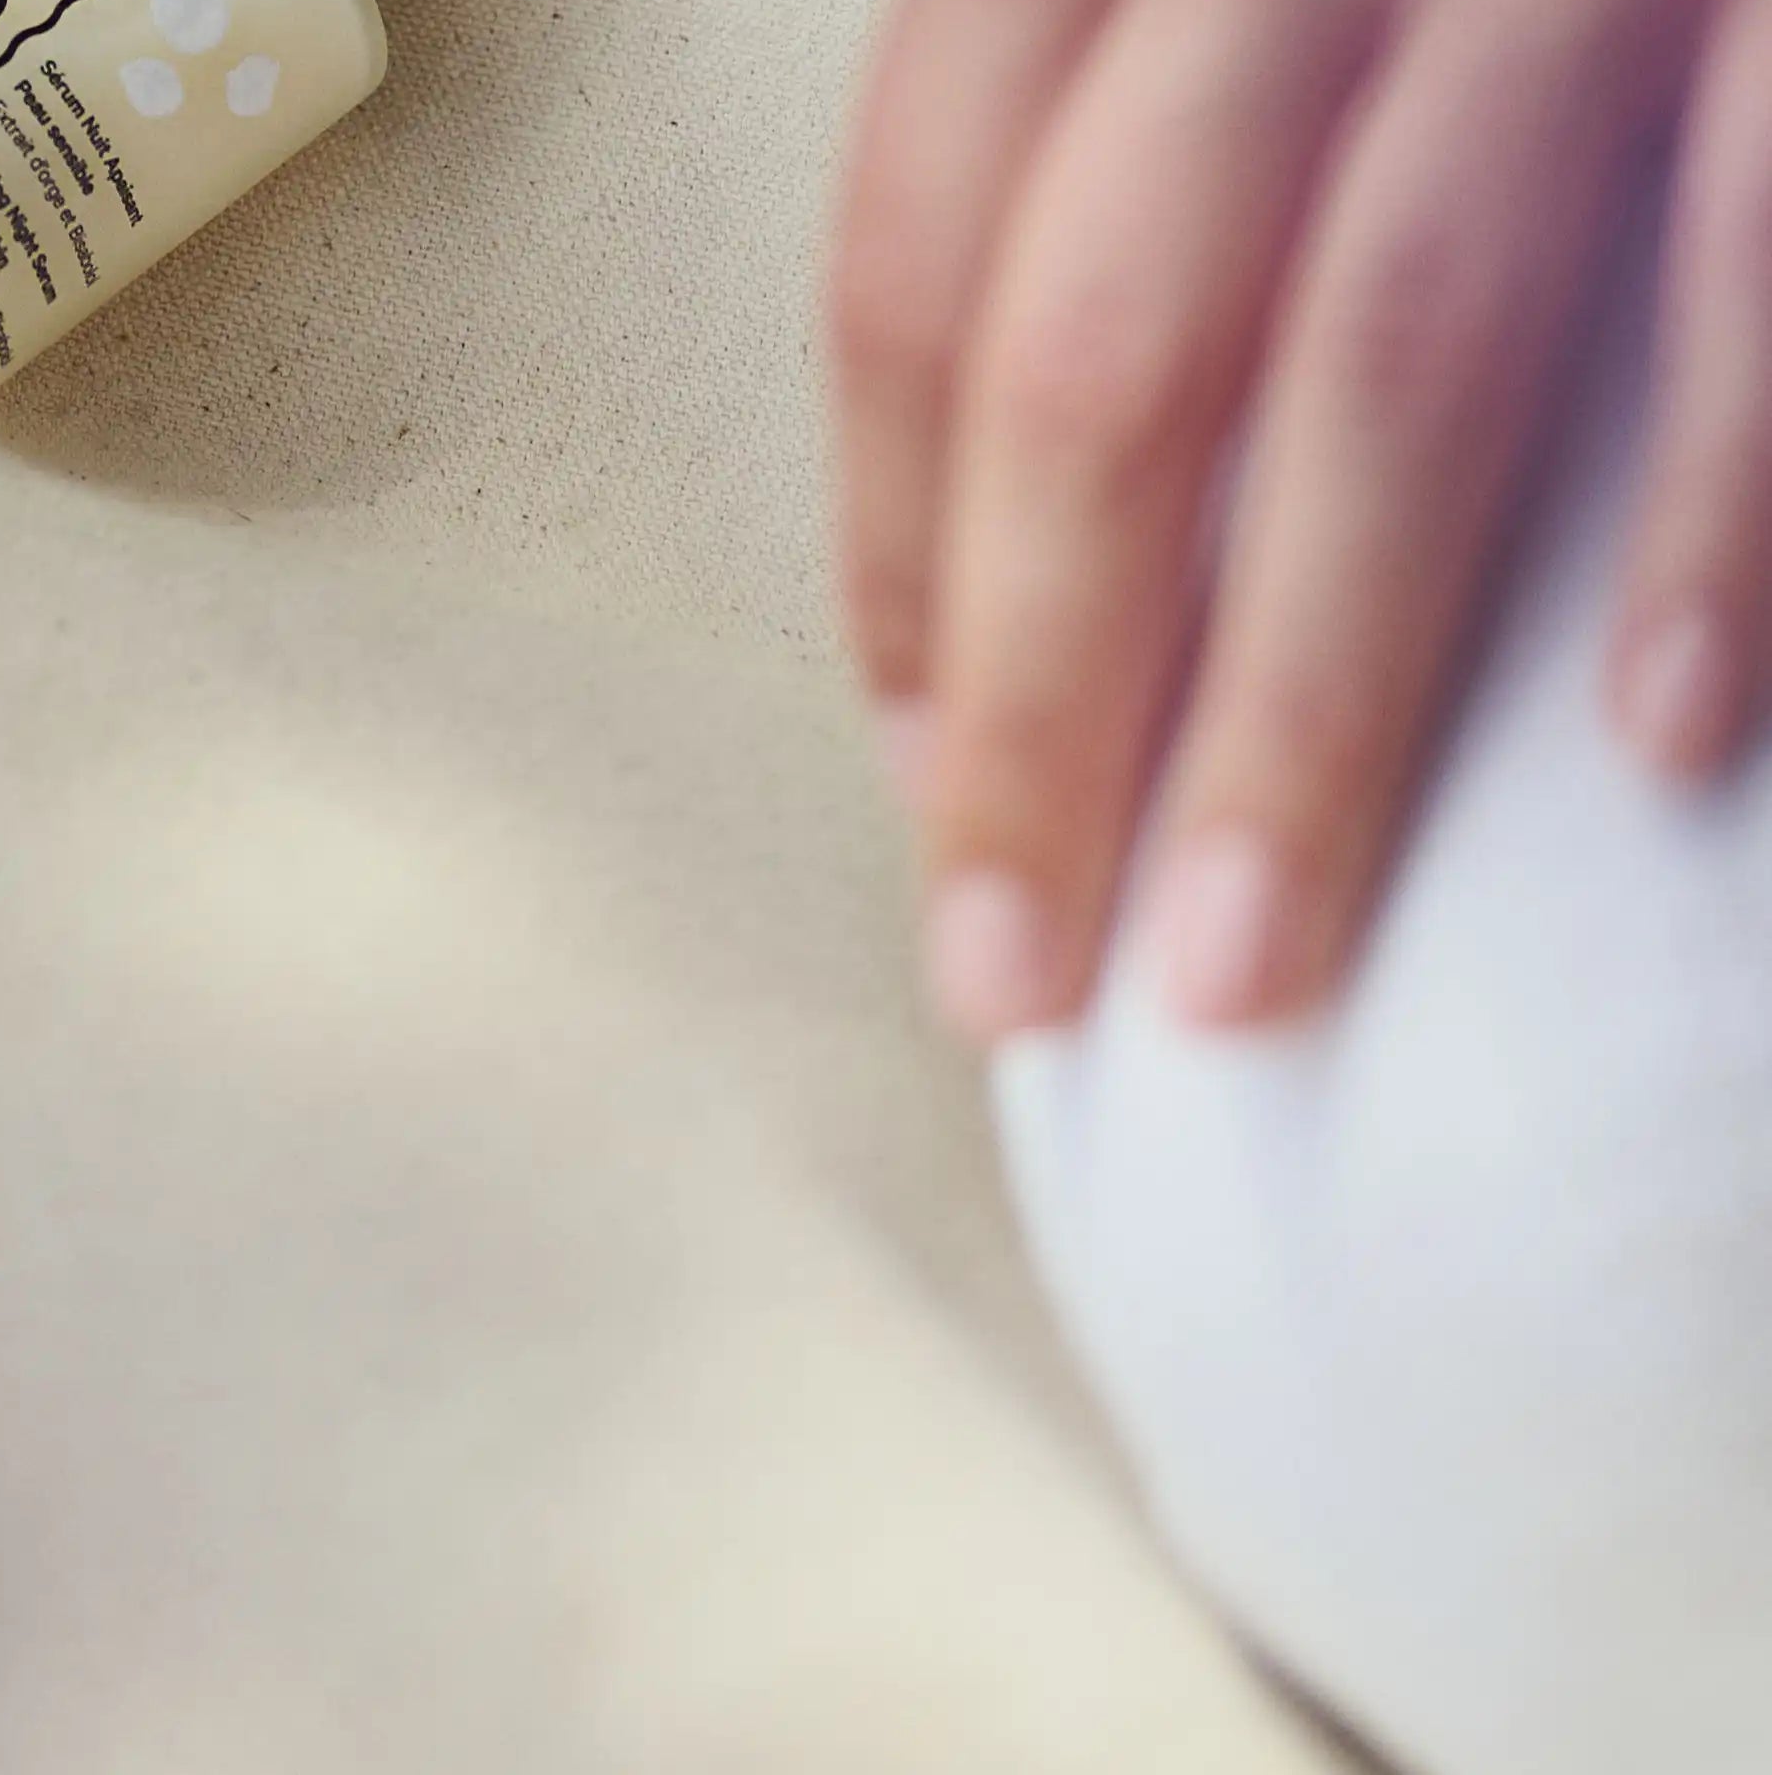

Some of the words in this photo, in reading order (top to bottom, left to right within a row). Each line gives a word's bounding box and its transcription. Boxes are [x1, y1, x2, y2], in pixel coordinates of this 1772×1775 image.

[14, 79, 52, 126] Peau
[47, 125, 94, 196] sensible
[40, 59, 86, 119] Sérum
[81, 115, 112, 158] Nuit
[103, 157, 144, 228] Apaisant
[5, 205, 40, 258] Night
[32, 253, 57, 305] Serum
[60, 208, 76, 229] et
